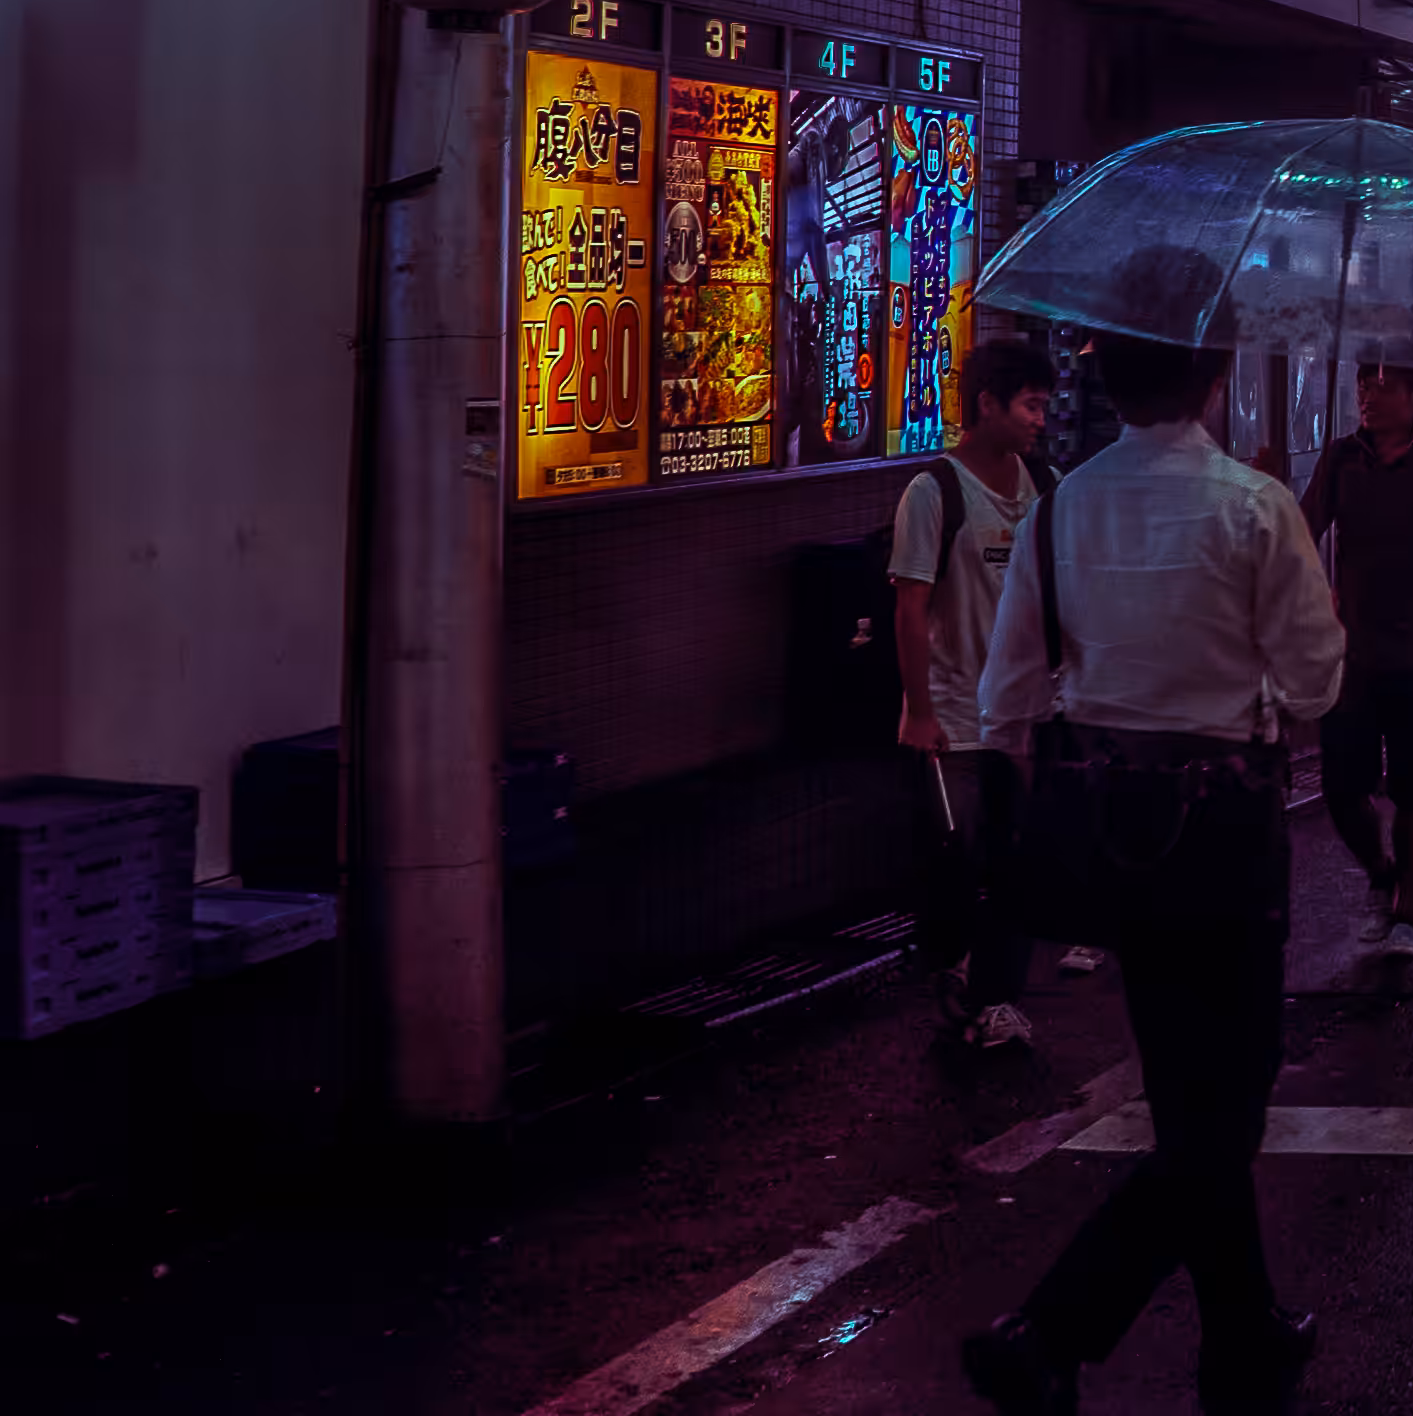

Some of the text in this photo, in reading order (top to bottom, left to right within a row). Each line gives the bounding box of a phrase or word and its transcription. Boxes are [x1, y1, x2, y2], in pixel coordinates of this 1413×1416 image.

[706, 19, 748, 61] 3F
[819, 40, 857, 78] 4F
[919, 57, 951, 93] 5F
[530, 97, 641, 184] 腹八分目
[566, 204, 645, 293] 全品均一
[922, 196, 936, 406] ドイツビアホール
[521, 295, 641, 436] ¥280
